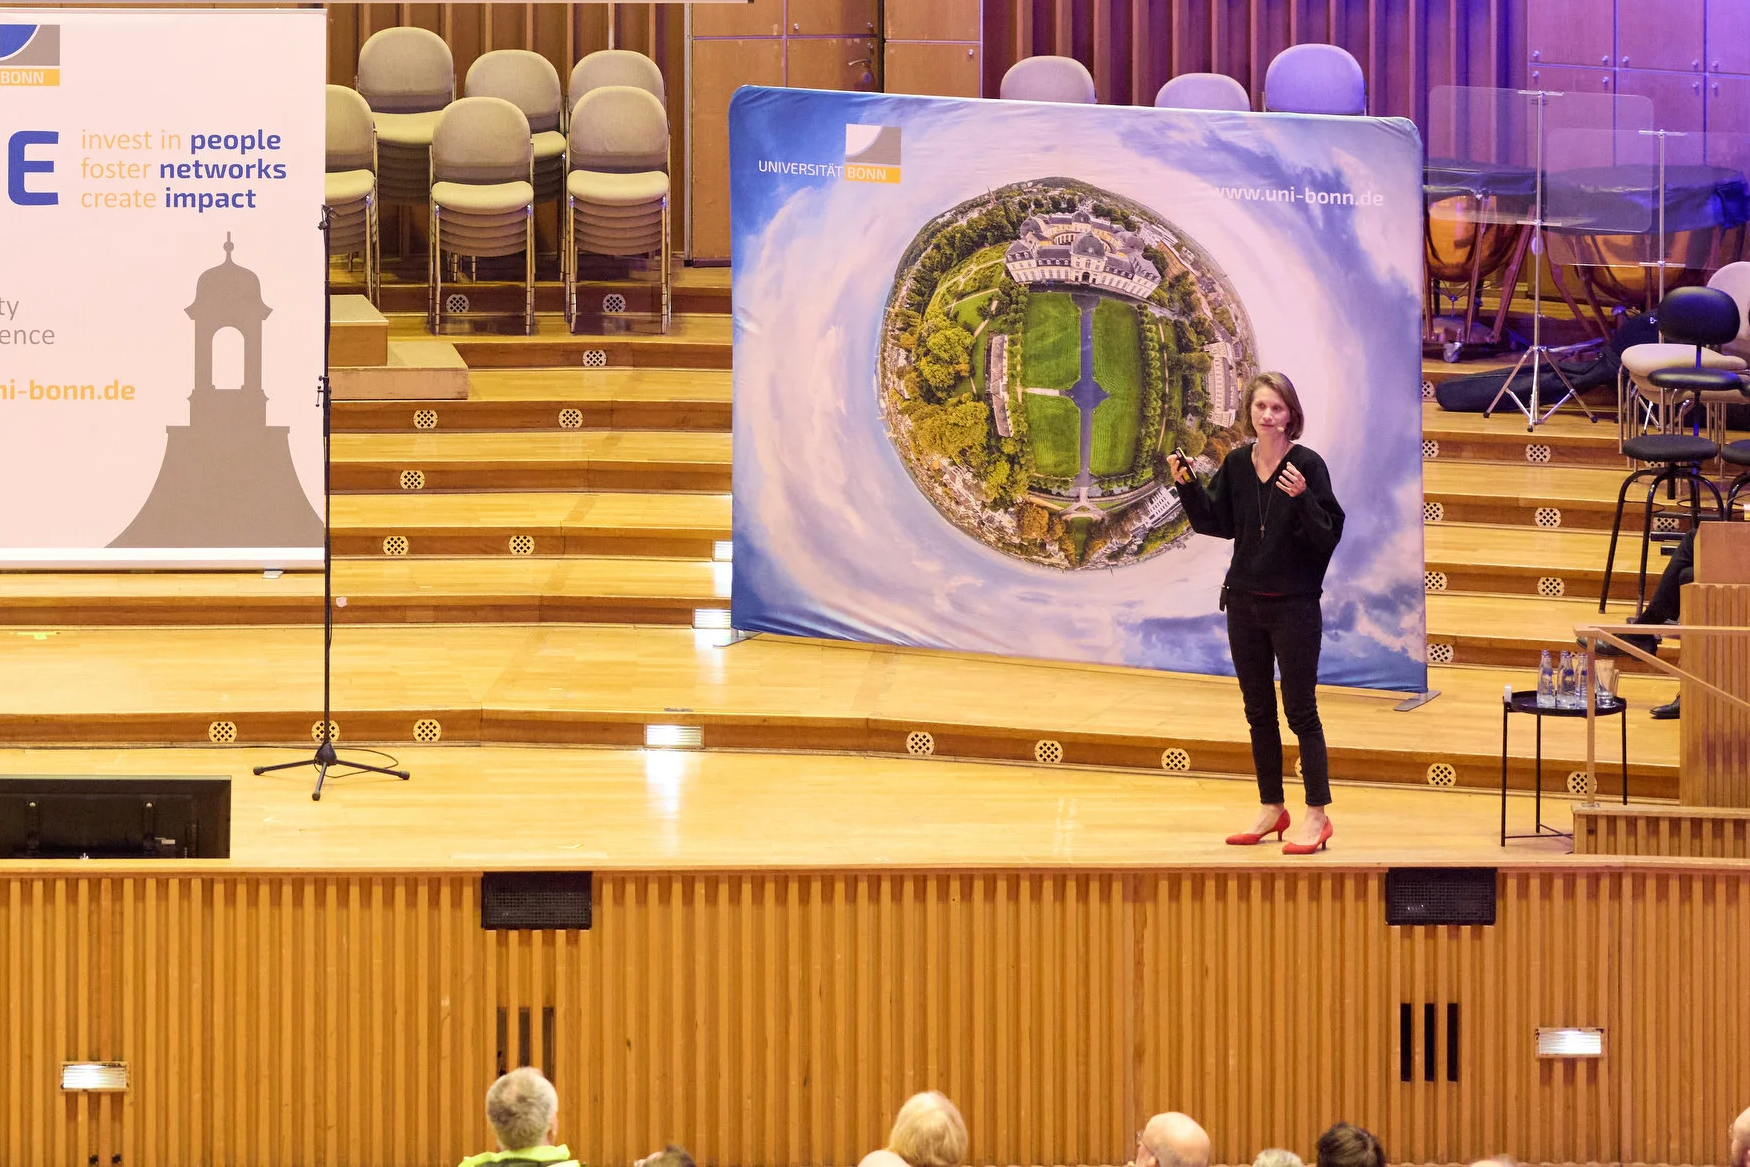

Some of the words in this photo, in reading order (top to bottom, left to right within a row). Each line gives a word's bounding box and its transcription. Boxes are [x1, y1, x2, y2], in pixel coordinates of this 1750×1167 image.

[0, 70, 45, 85] BONN
[80, 128, 153, 151] invest
[160, 129, 182, 151] in
[190, 129, 282, 155] people
[80, 156, 152, 179] foster
[159, 158, 287, 179] networks
[758, 159, 844, 178] UNIVERSITÄT
[847, 166, 887, 181] BONN
[80, 188, 157, 209] create
[164, 187, 257, 213] impact
[1215, 186, 1384, 207] www.uni-bonn.de
